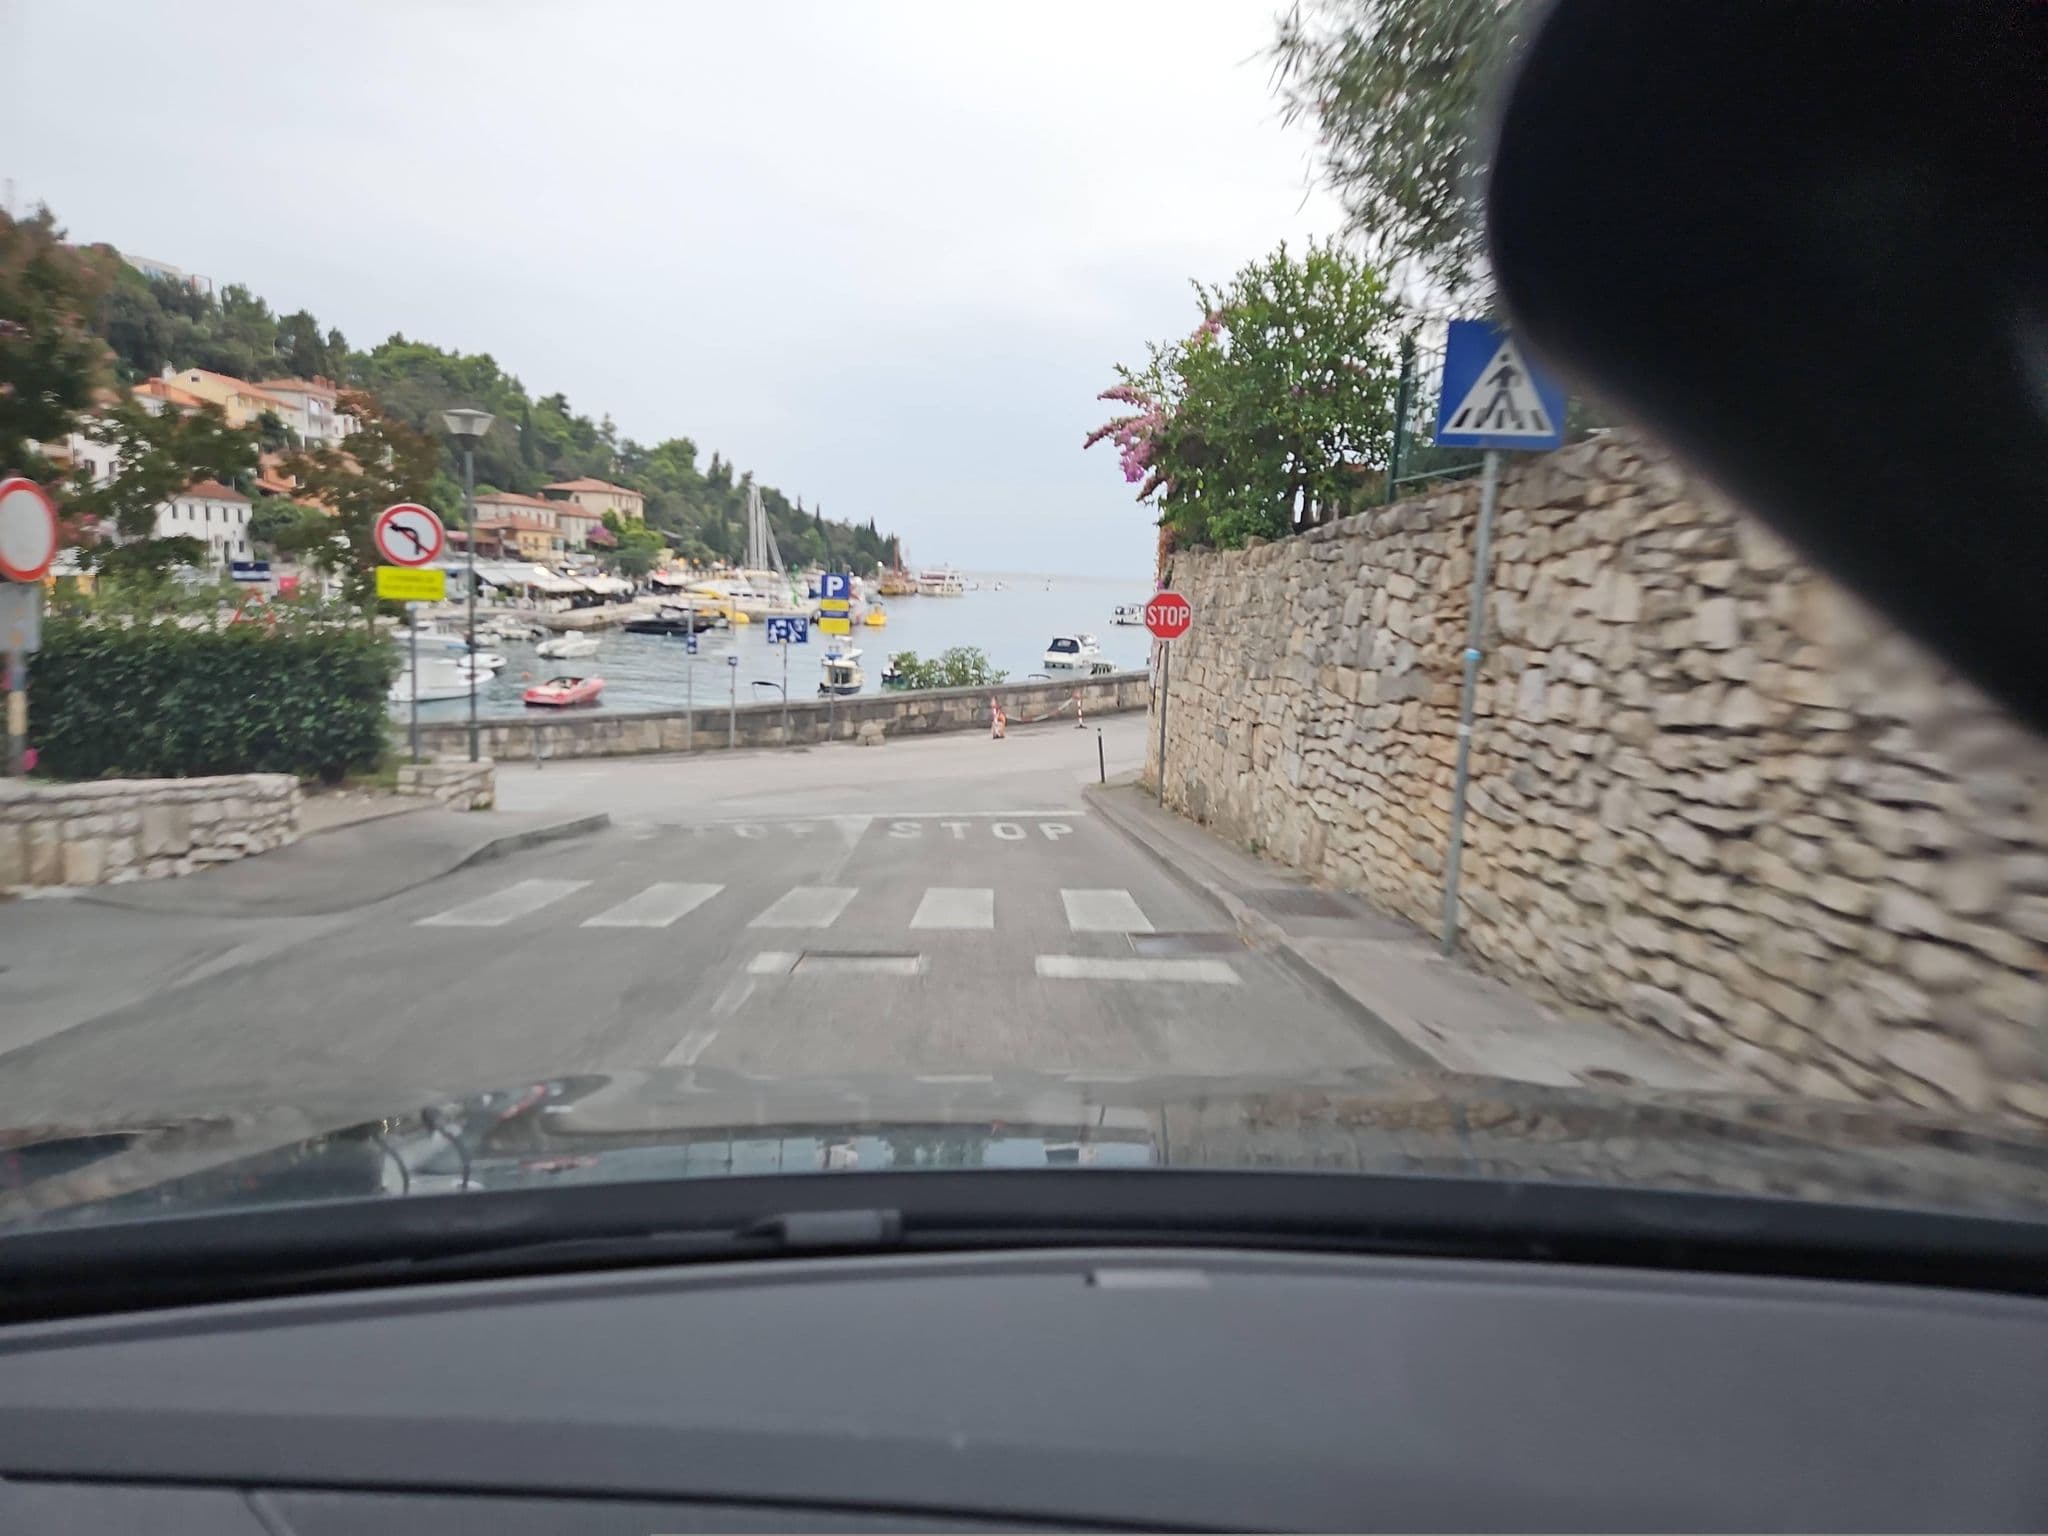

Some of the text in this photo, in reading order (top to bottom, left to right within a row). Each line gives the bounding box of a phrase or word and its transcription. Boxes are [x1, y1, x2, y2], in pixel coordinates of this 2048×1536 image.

[826, 576, 844, 597] P
[1147, 605, 1189, 627] STOP
[887, 822, 1074, 841] STOP
